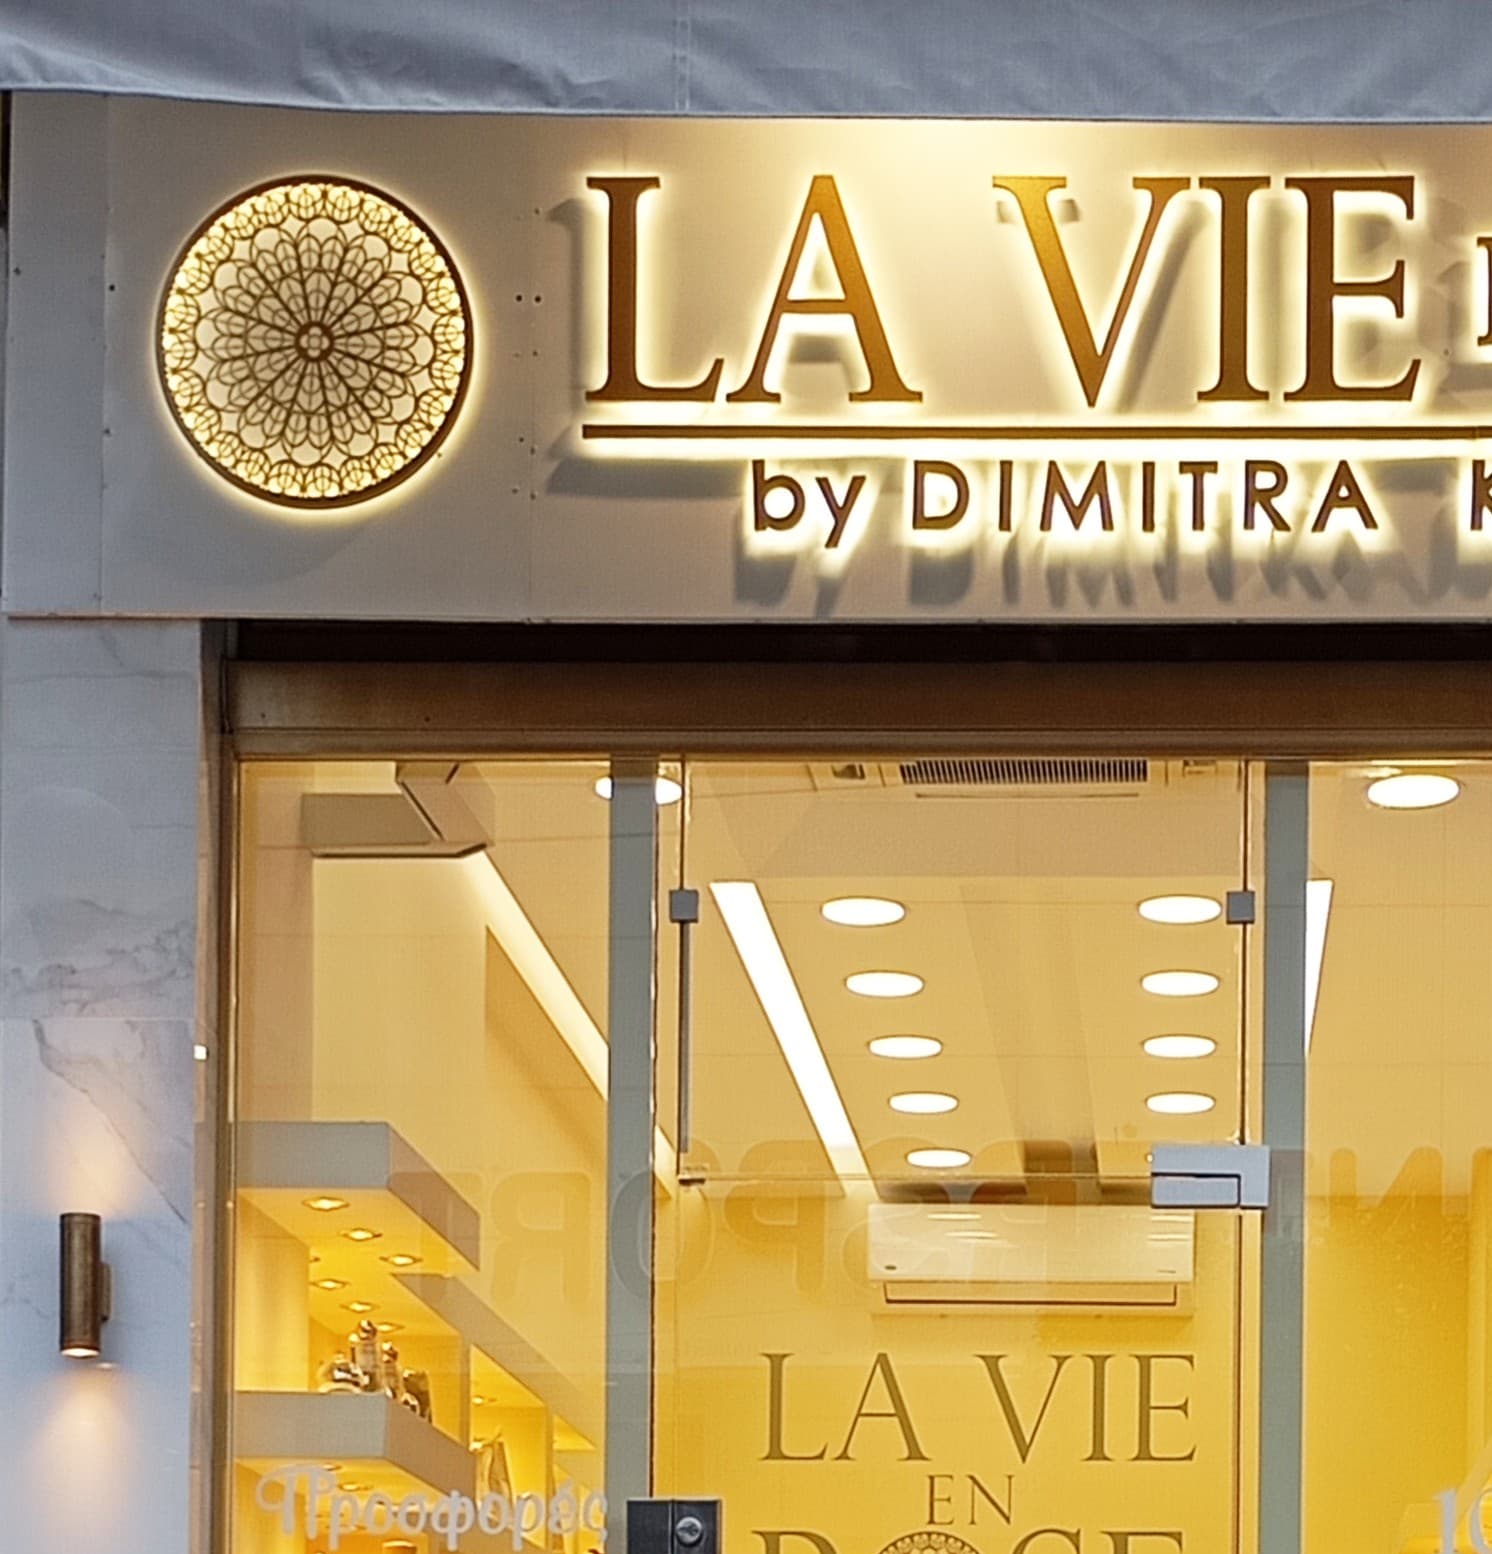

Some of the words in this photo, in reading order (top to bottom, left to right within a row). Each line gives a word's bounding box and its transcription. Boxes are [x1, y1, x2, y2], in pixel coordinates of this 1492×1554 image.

[585, 174, 924, 403] LA
[991, 174, 1423, 408] VIE
[751, 458, 867, 549] by
[911, 459, 1379, 533] DIMITRA
[757, 1352, 931, 1462] LA
[973, 1353, 1198, 1464] VIE
[925, 1474, 1015, 1526] EN
